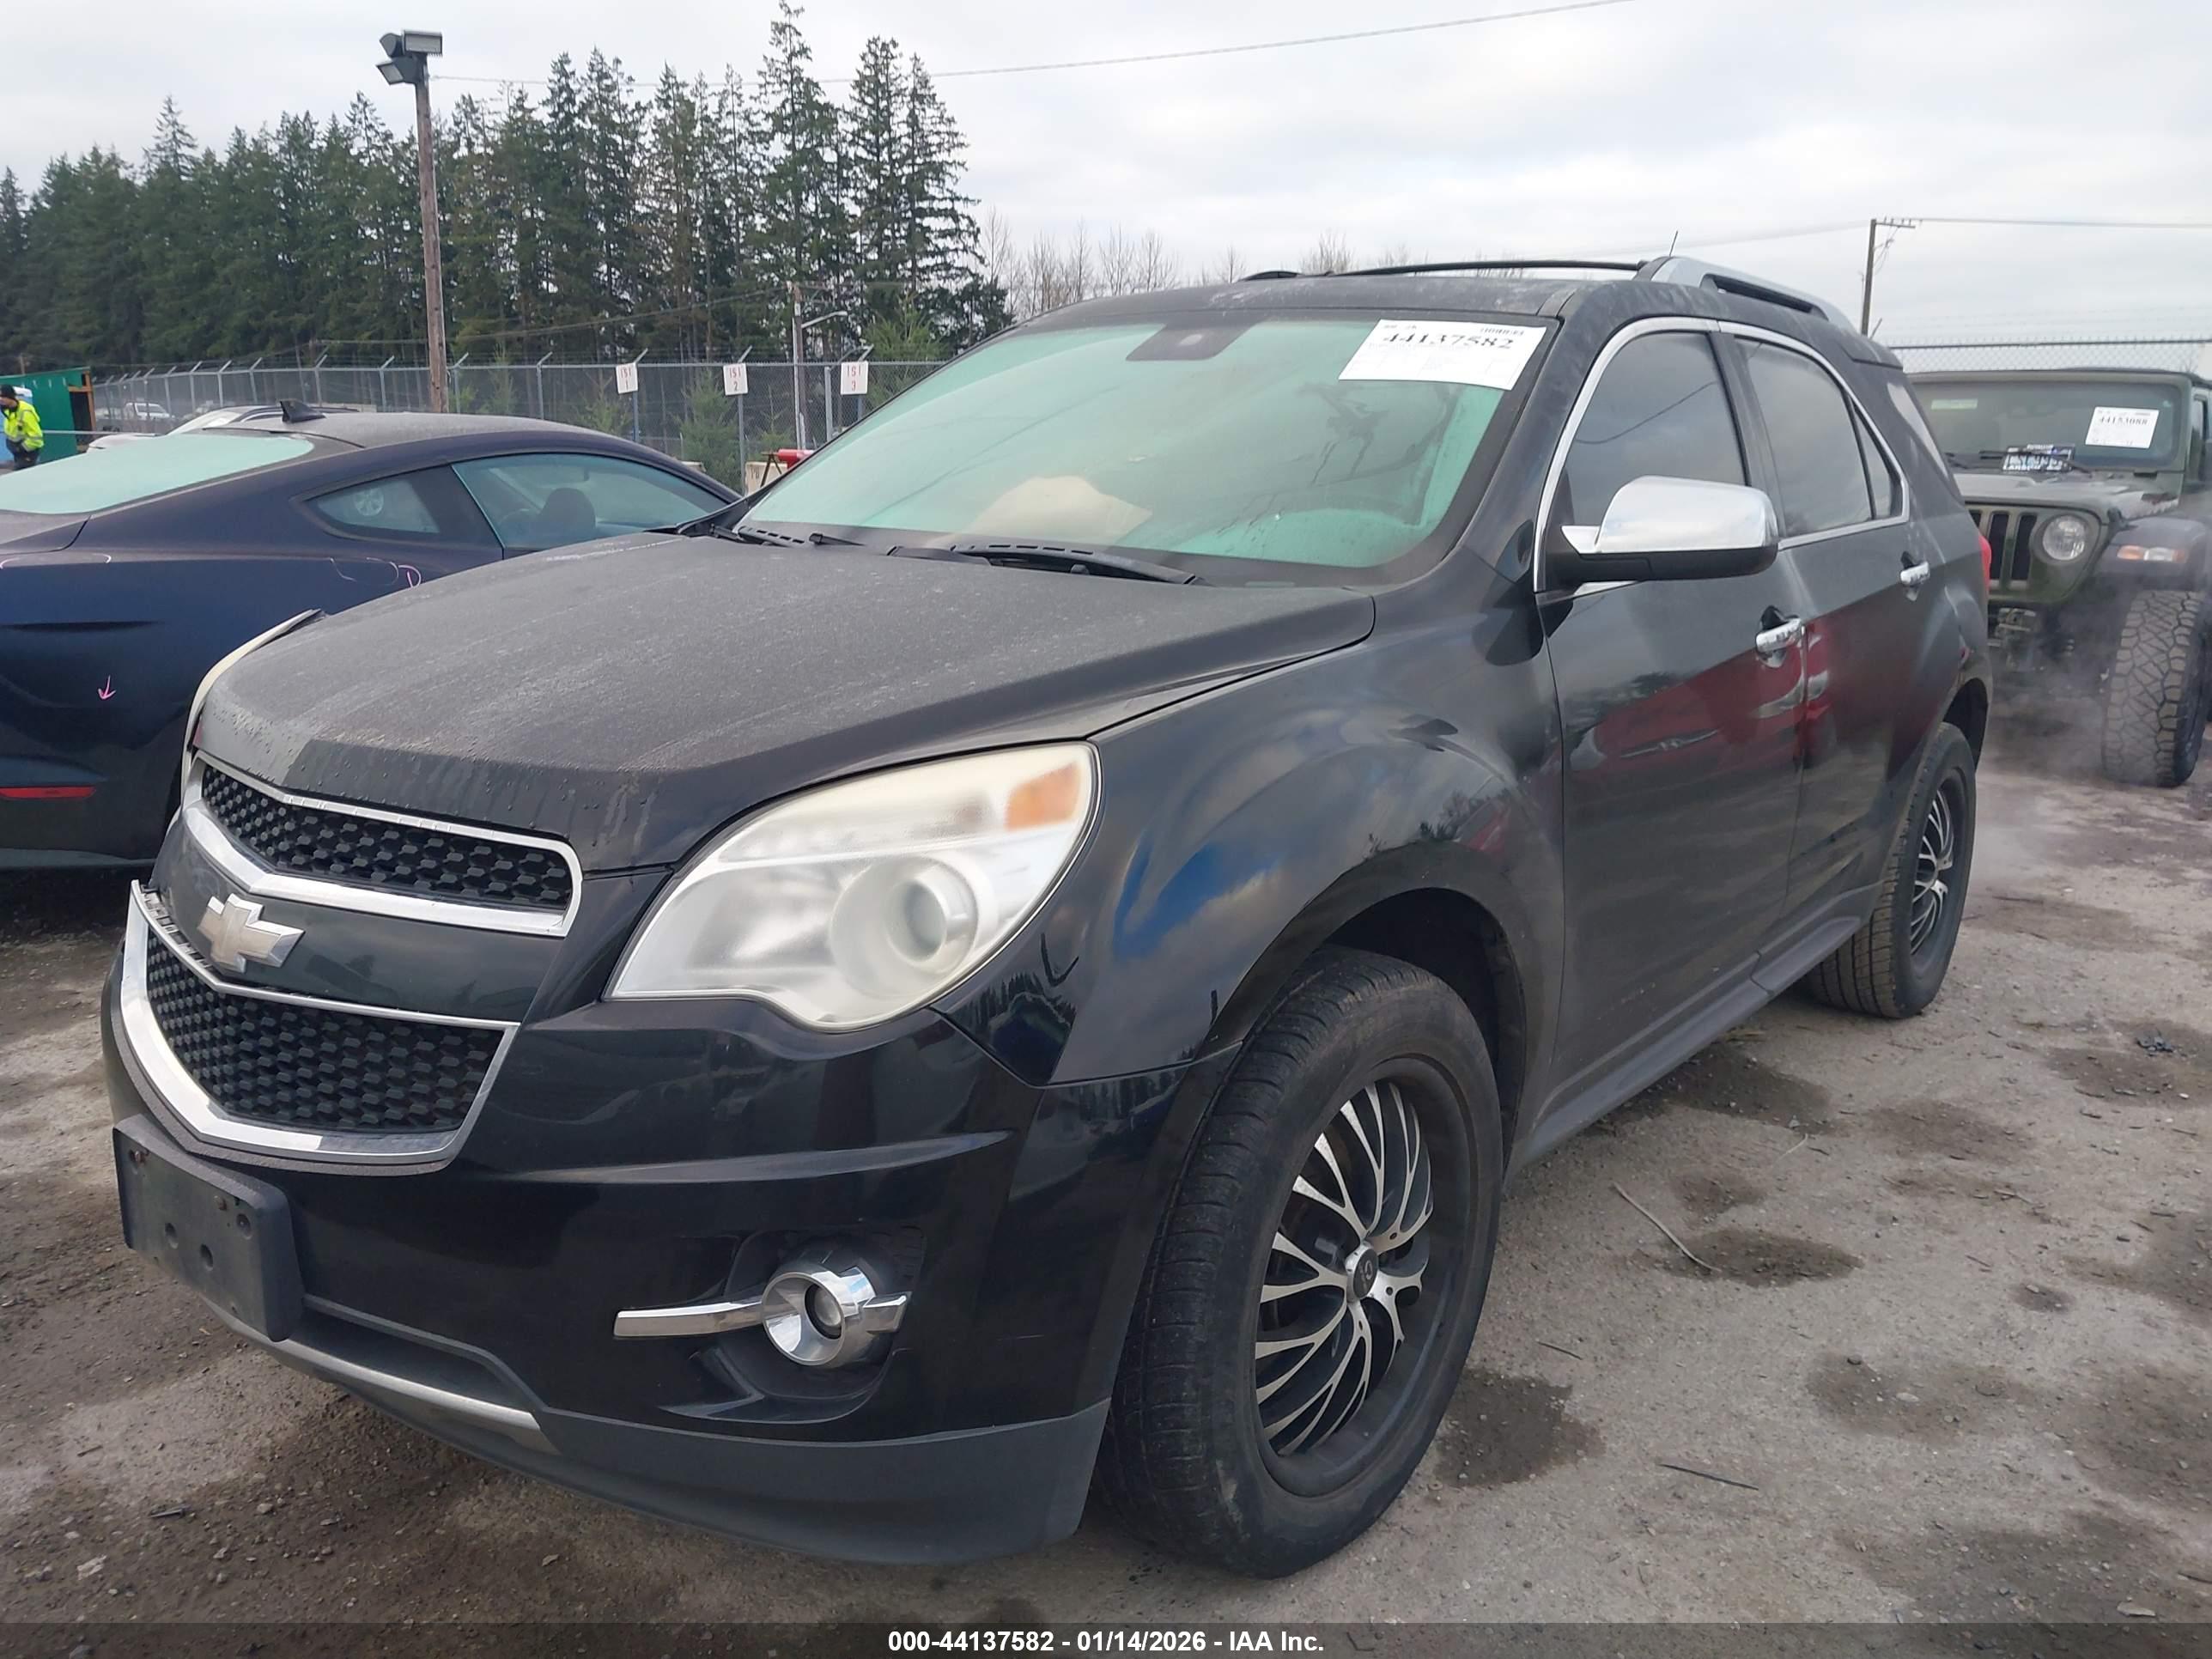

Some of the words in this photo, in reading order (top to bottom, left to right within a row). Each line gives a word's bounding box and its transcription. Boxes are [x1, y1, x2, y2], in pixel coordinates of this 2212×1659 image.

[1383, 333, 1513, 349] 44137582
[733, 380, 738, 392] 2
[851, 380, 856, 392] 3
